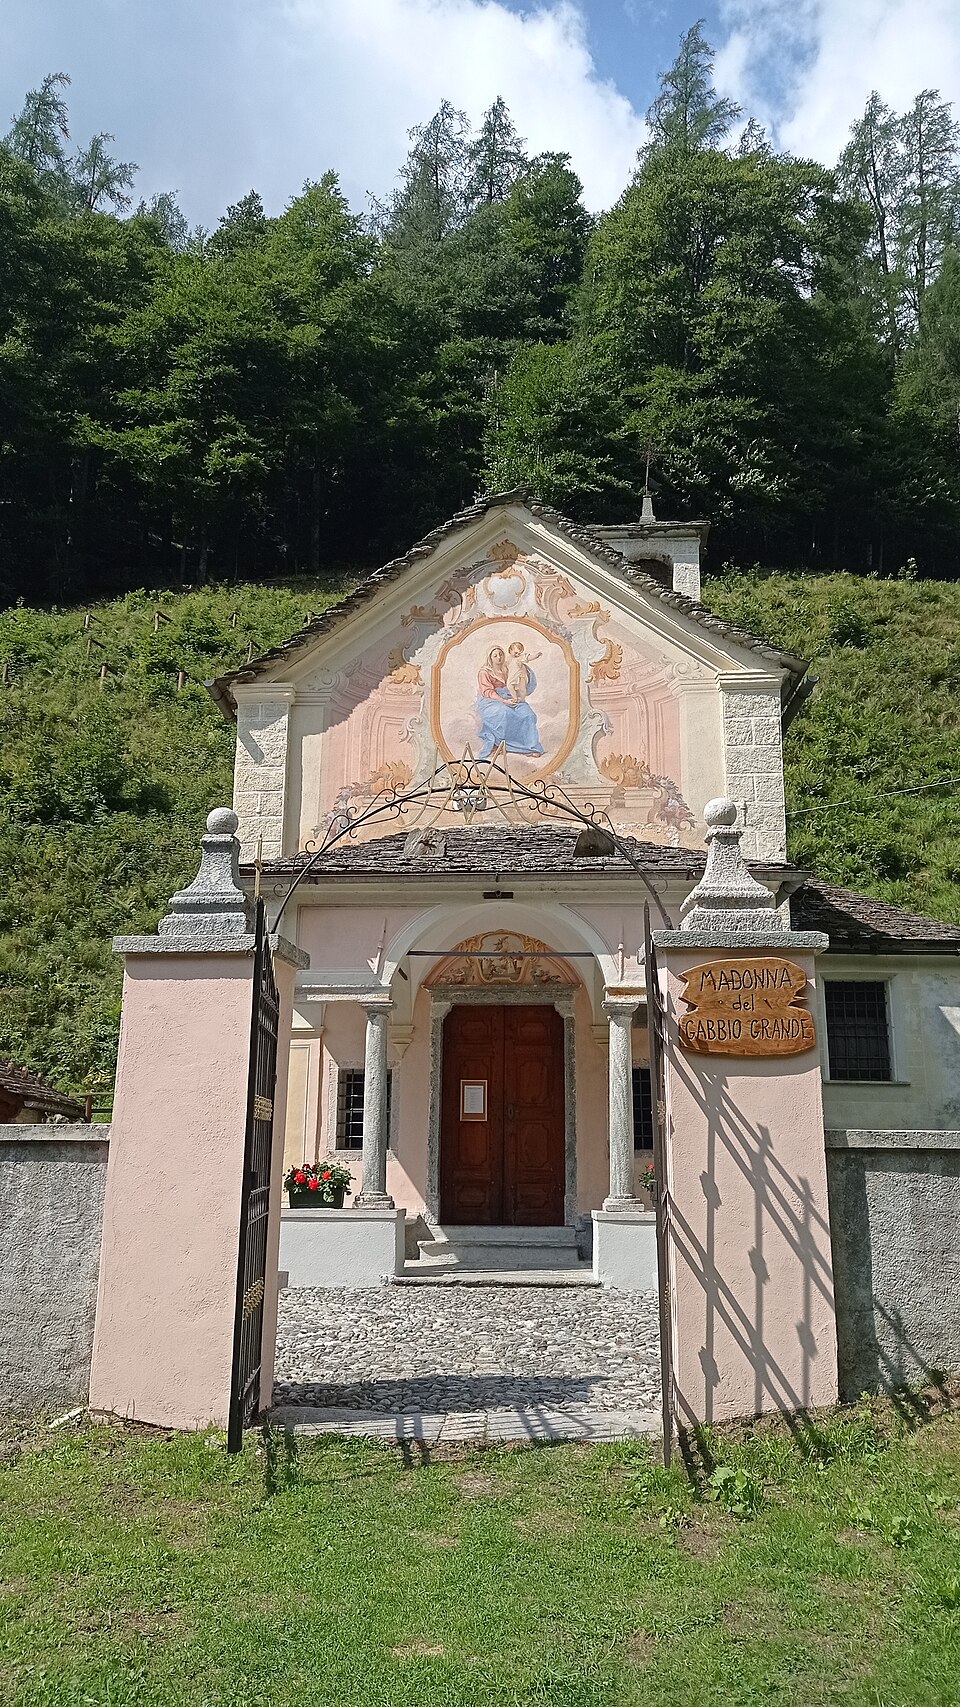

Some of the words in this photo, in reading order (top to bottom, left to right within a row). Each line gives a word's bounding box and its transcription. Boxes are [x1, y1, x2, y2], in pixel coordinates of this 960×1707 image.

[700, 968, 792, 991] MADONNA
[732, 994, 755, 1011] del
[685, 1019, 742, 1040] GABBIO
[750, 1018, 813, 1039] GRANDE
